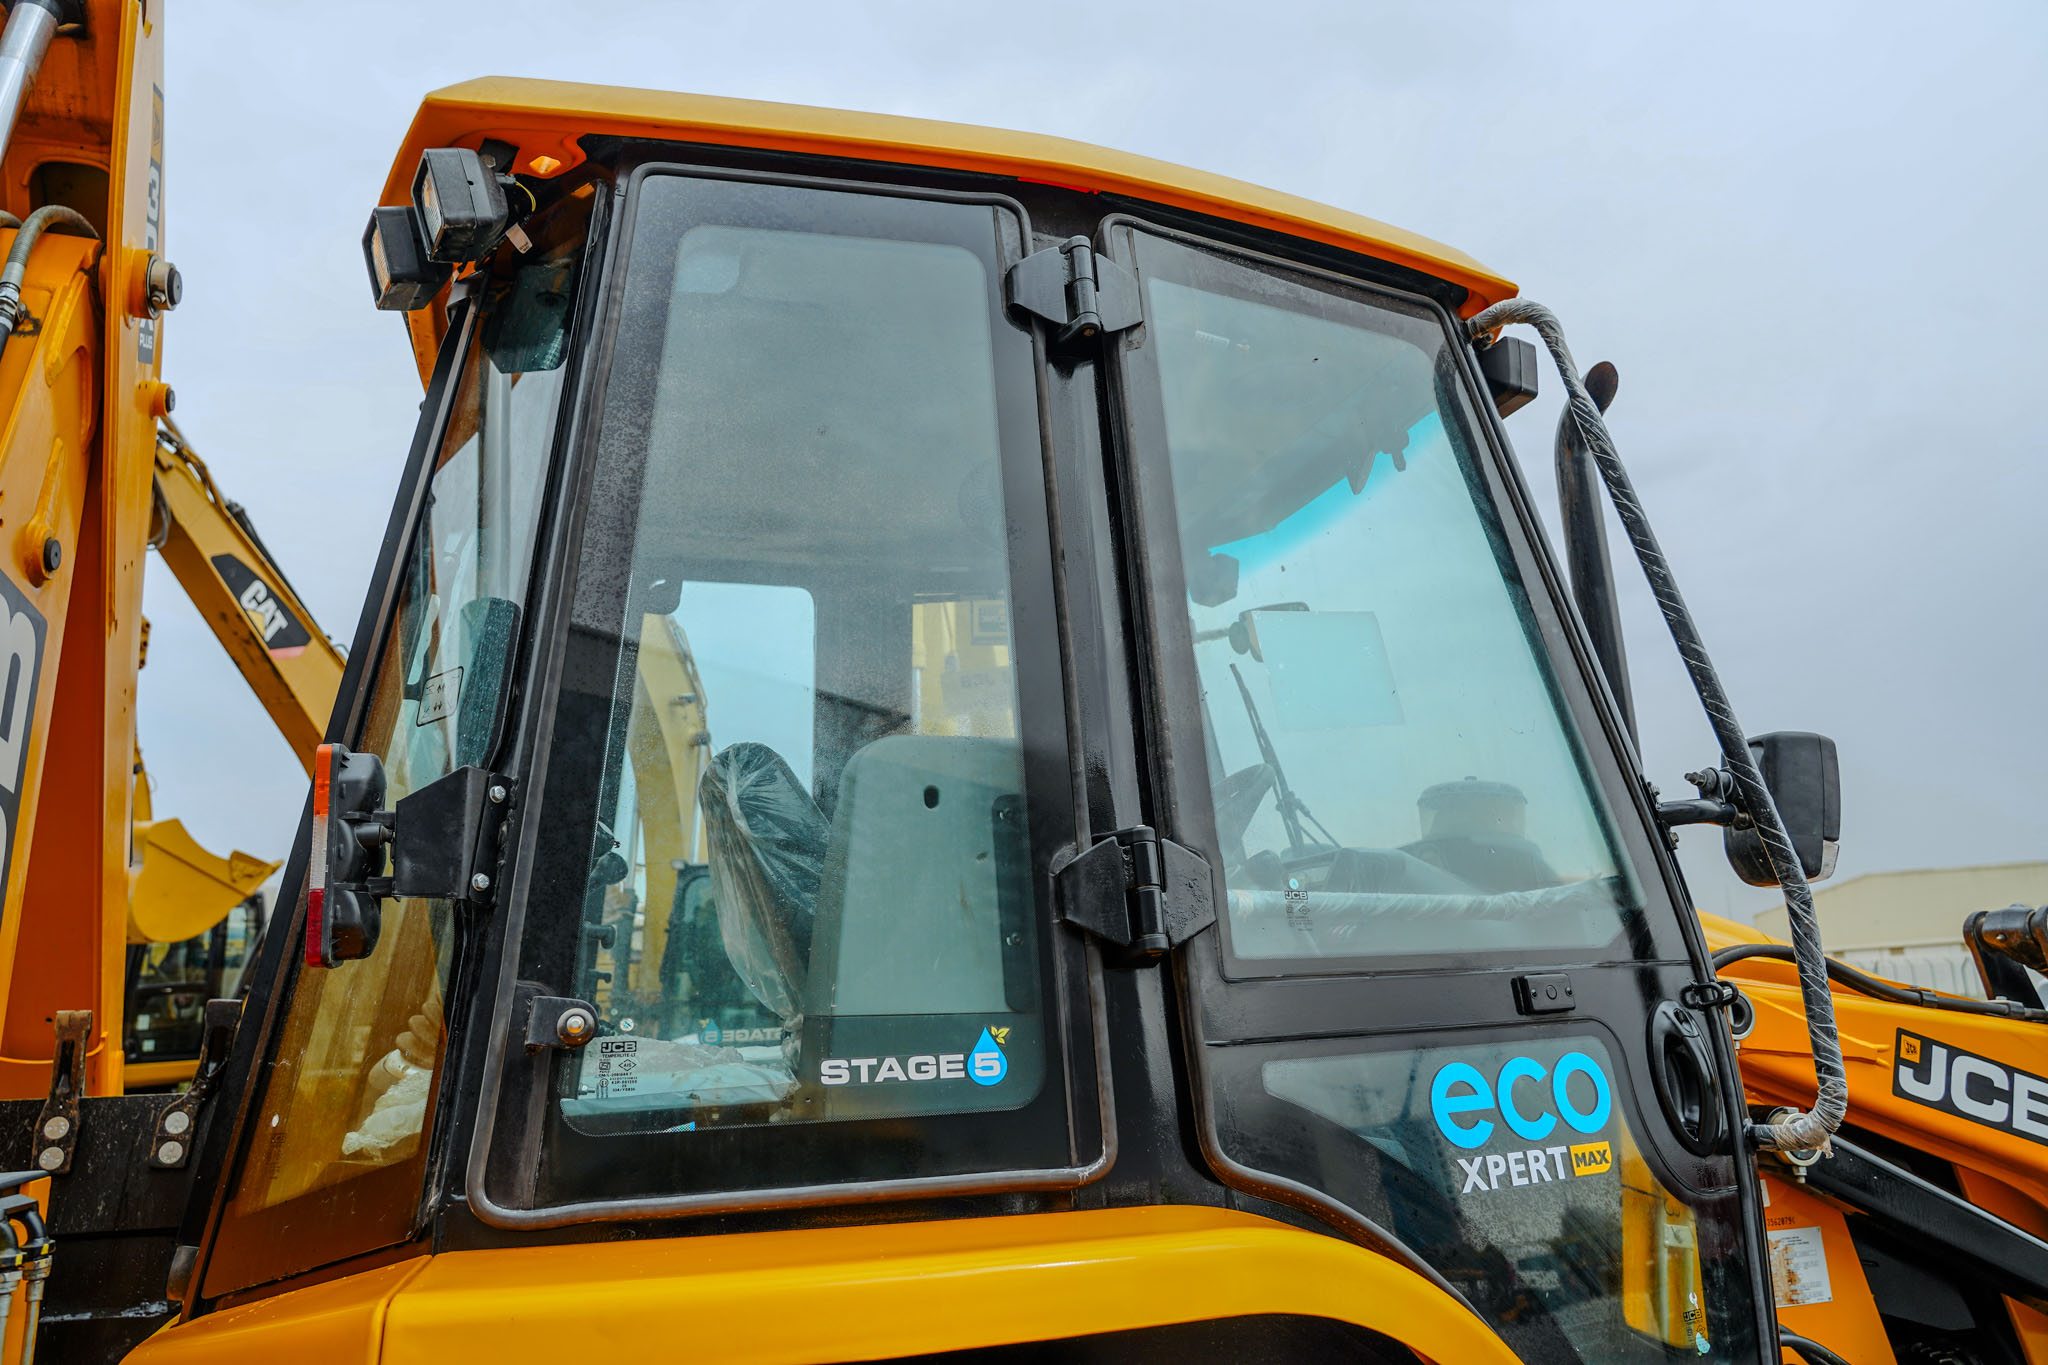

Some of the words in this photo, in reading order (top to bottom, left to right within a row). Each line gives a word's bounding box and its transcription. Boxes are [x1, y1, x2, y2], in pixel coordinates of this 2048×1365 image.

[139, 332, 153, 349] PLUS
[239, 580, 288, 642] CAT
[1285, 891, 1308, 899] JCB
[602, 1042, 636, 1052] JCB
[821, 1054, 966, 1085] STAGE
[974, 1052, 1000, 1077] 5
[1431, 1052, 1611, 1149] eco
[1457, 1145, 1568, 1194] XPERT
[1573, 1149, 1610, 1169] MAX
[1683, 1309, 1702, 1321] JCB
